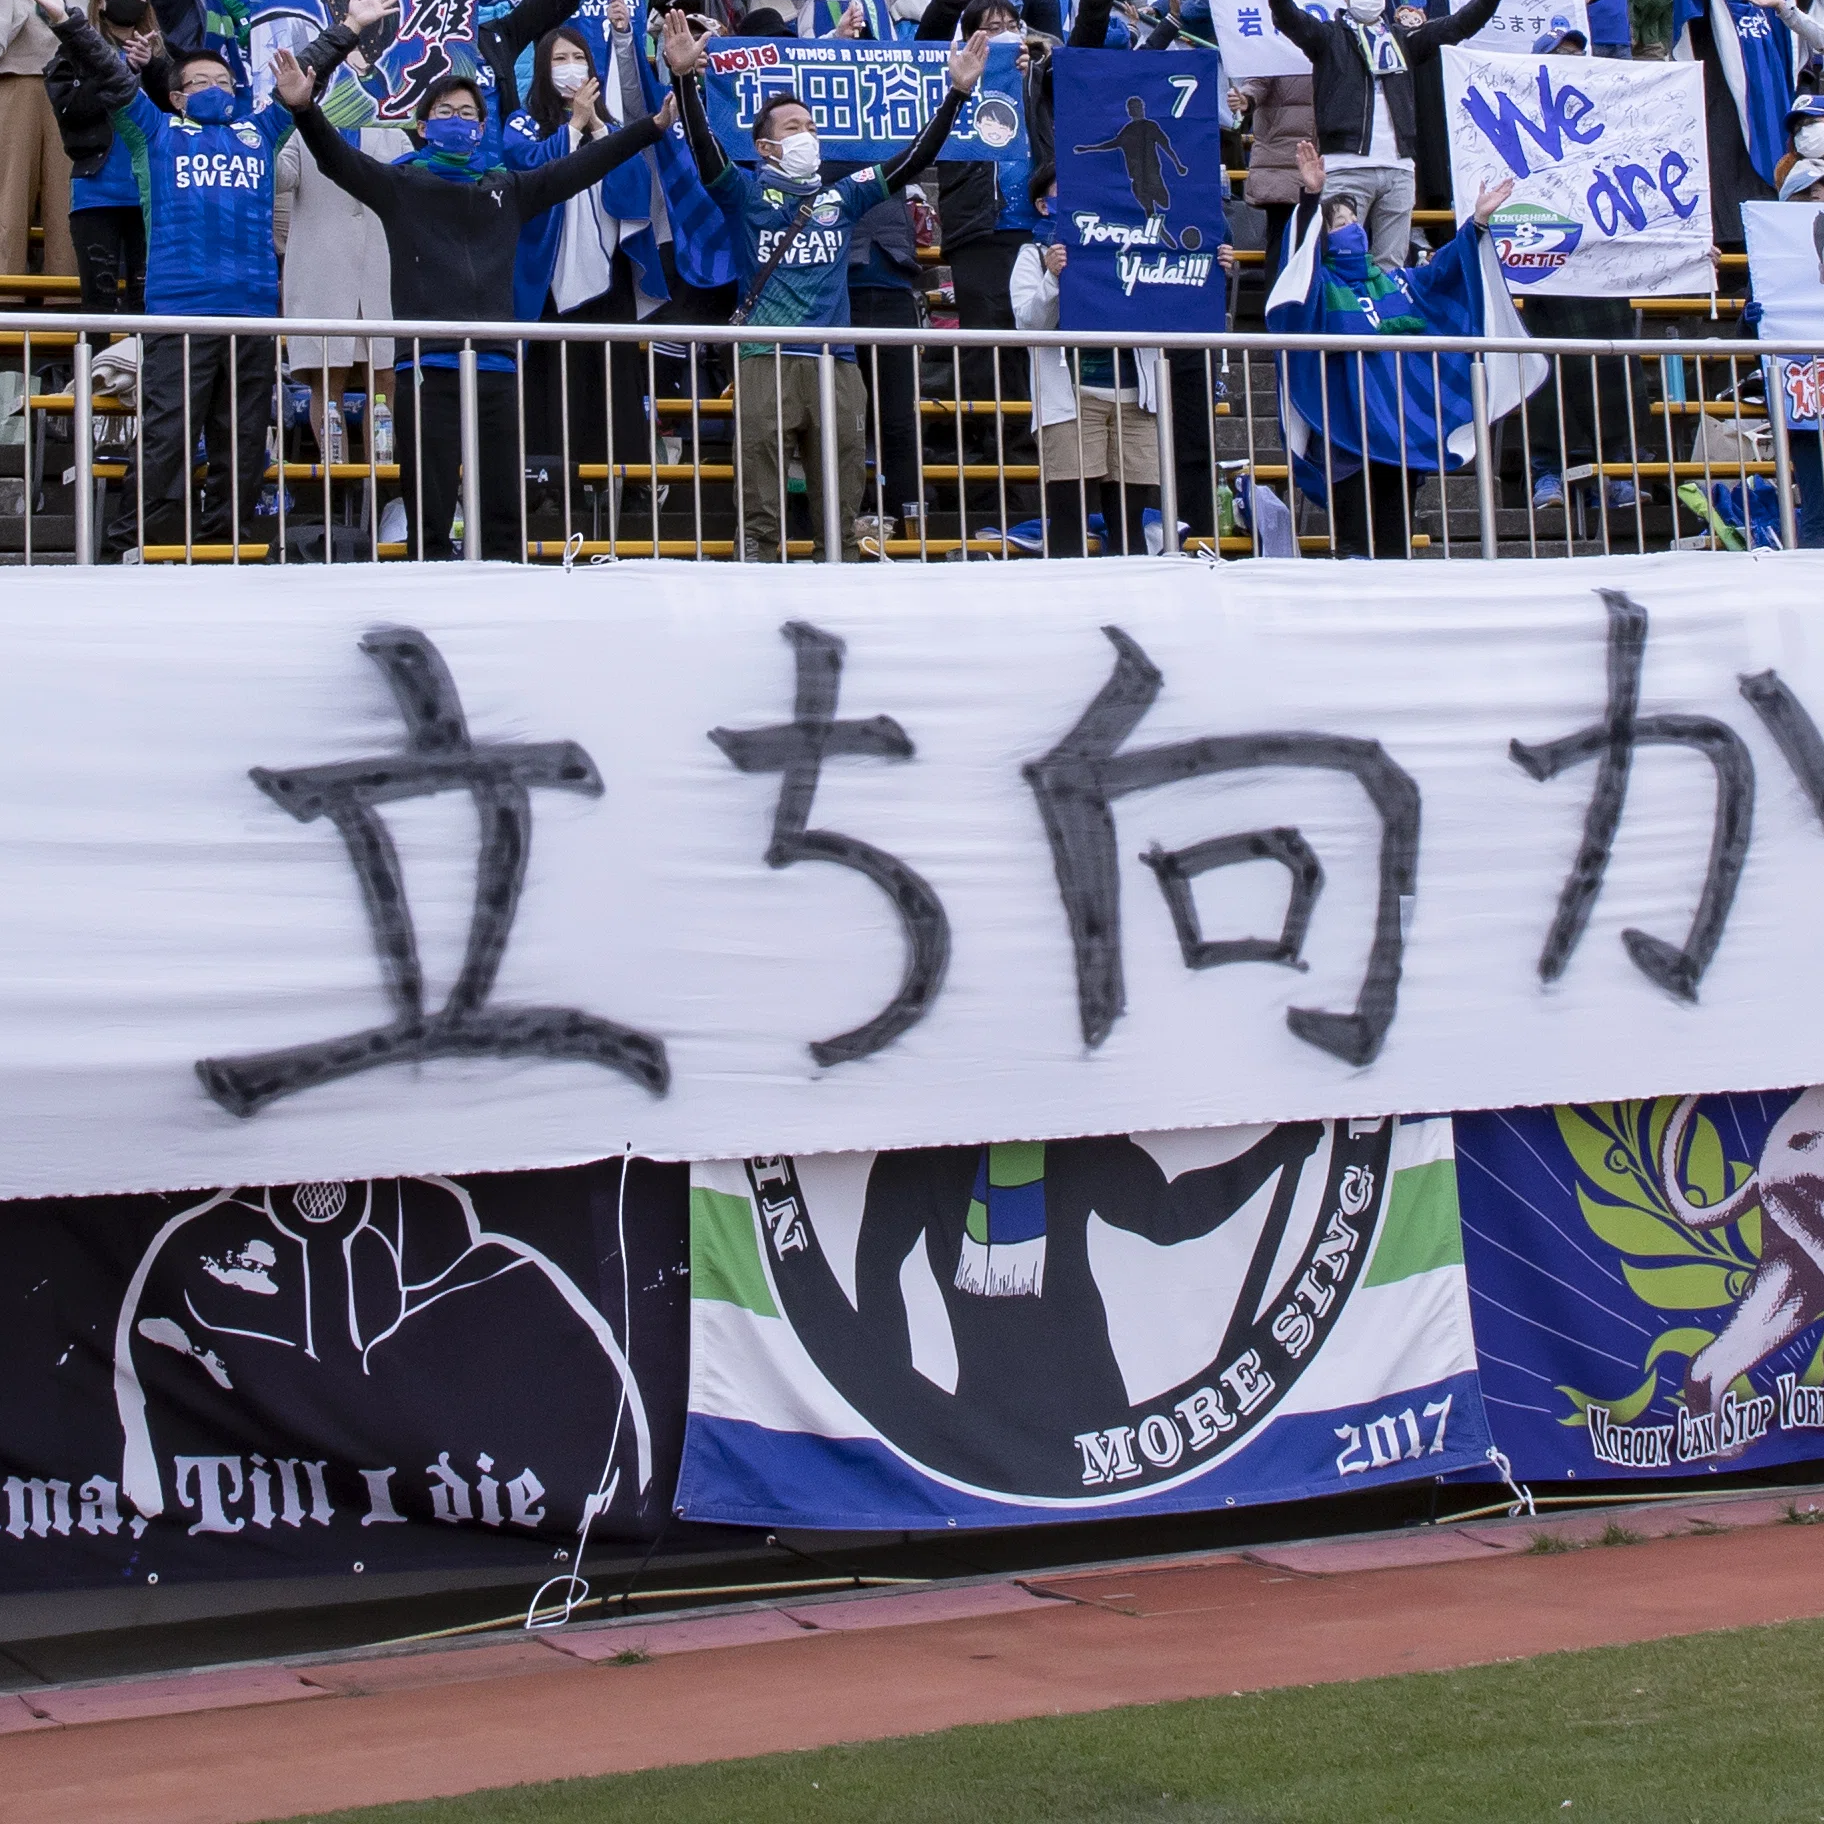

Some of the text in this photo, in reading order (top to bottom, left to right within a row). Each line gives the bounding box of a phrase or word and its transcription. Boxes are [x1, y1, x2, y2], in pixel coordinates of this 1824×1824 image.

[709, 44, 780, 76] NO.19
[785, 46, 838, 63] VAMOS
[918, 50, 954, 66] JUNT
[1167, 74, 1199, 119] 7
[1460, 64, 1606, 180] We
[176, 154, 265, 176] POCARI
[176, 170, 261, 190] SWEAT
[1586, 149, 1699, 237] are
[1072, 210, 1165, 253] Forza!!
[1492, 212, 1560, 224] TOKUSHIMA
[1116, 251, 1213, 297] Yudai!!!
[1072, 1162, 1376, 1488] MORE SING
[1333, 1394, 1454, 1478] 2017
[173, 1454, 341, 1539] Till
[425, 1452, 548, 1530] die
